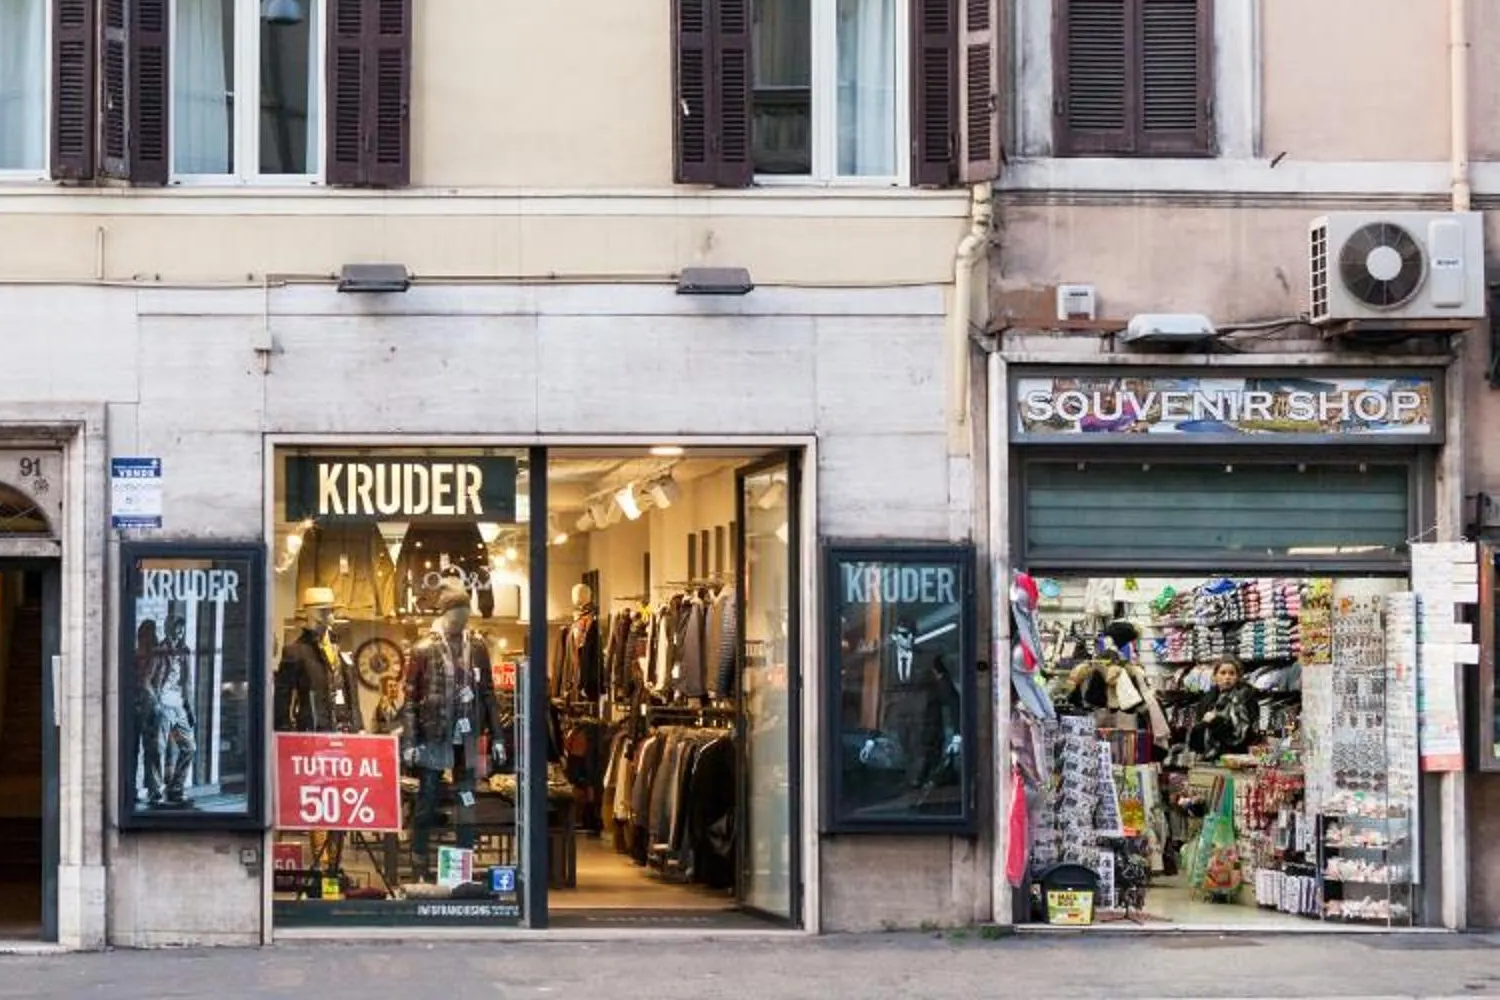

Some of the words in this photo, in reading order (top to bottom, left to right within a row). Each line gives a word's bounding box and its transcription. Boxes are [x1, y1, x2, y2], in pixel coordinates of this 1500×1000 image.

[1025, 390, 1273, 421] SOUVENIR
[1288, 390, 1421, 421] SHOP
[20, 457, 41, 476] 91
[318, 463, 484, 516] KRUDER
[143, 568, 239, 602] KRUDER
[847, 567, 956, 603] KRUDER
[292, 756, 353, 777] TUTTO
[359, 758, 383, 777] AL
[300, 786, 375, 824] 50%
